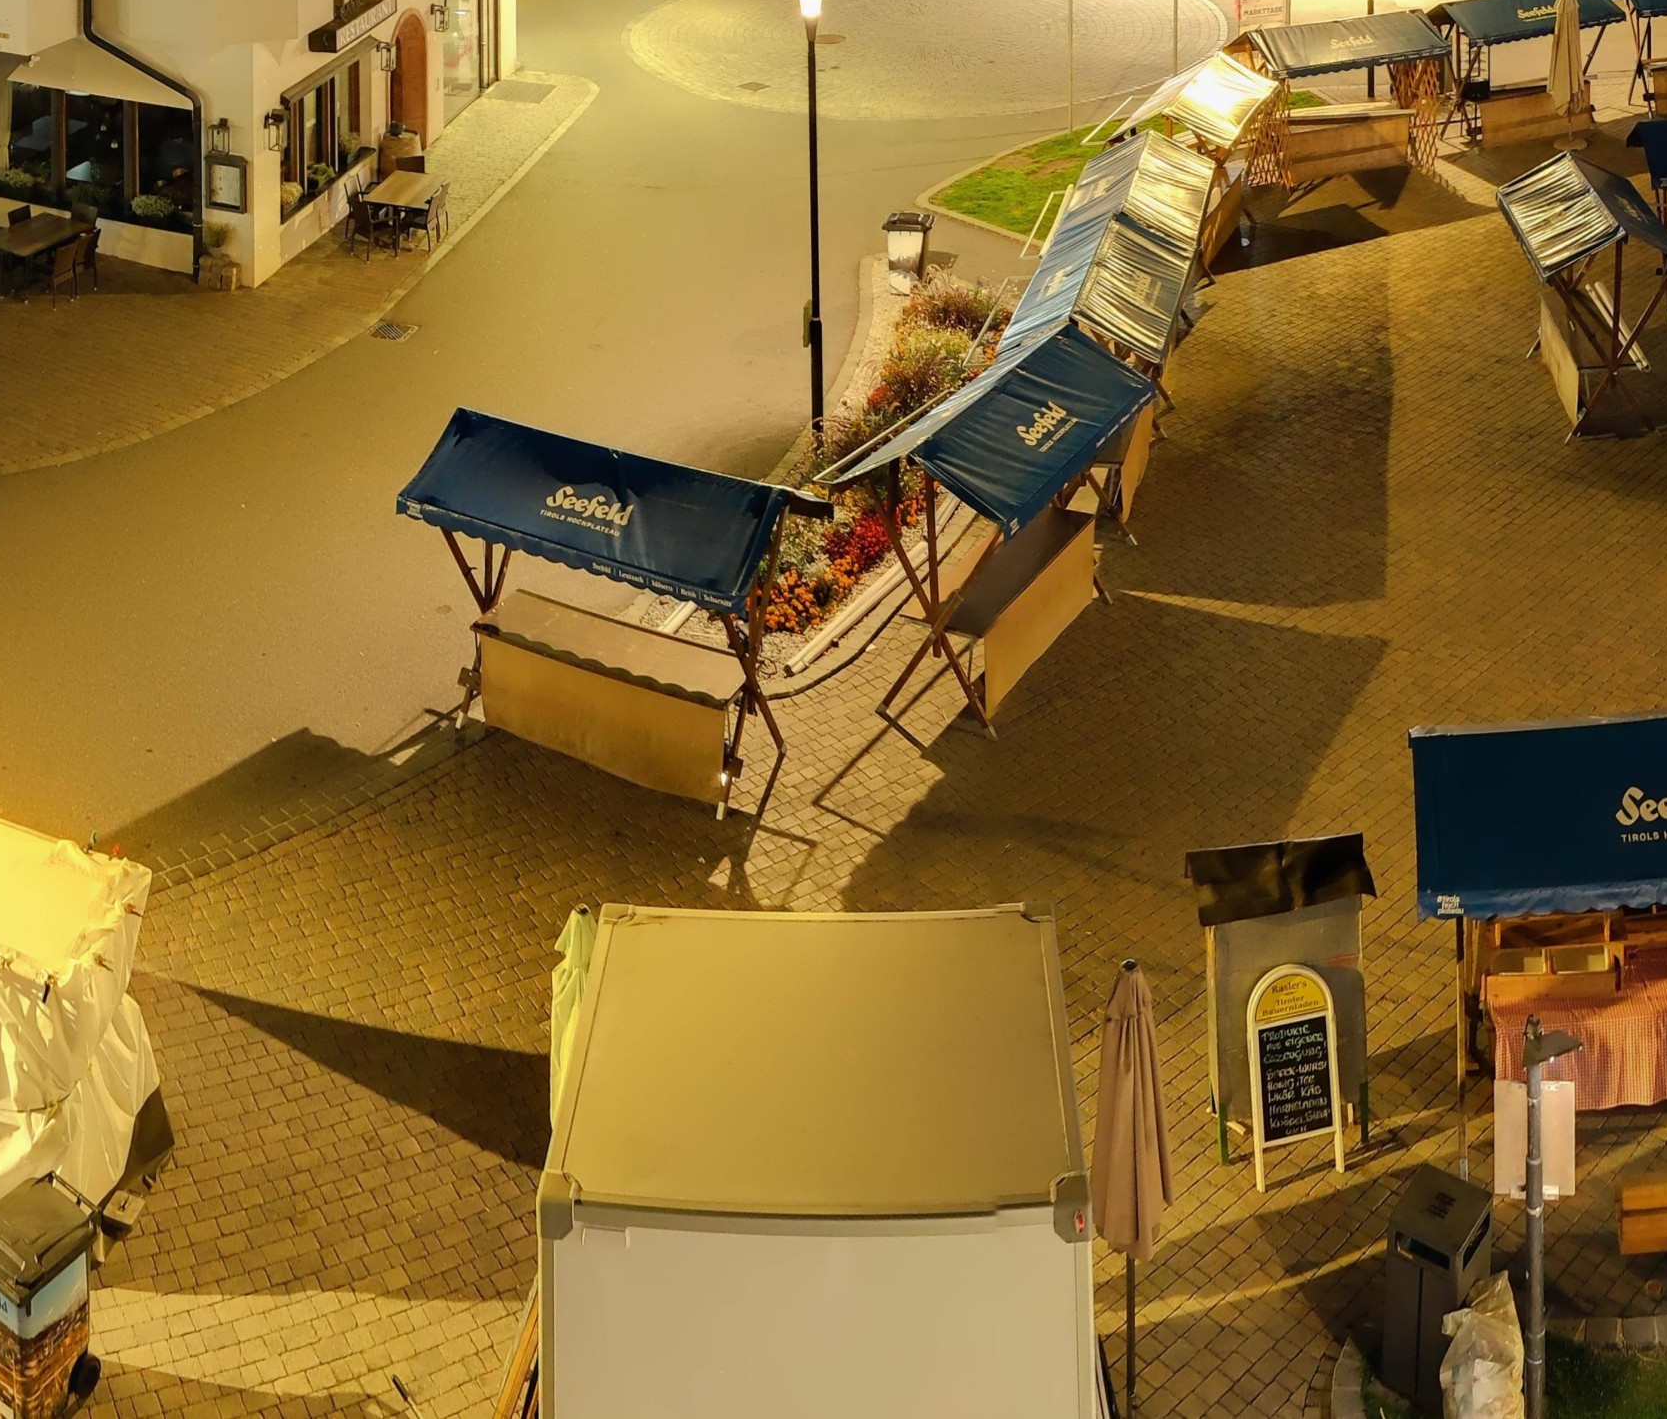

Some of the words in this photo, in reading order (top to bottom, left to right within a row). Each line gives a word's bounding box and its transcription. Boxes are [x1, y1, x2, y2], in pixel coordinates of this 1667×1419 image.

[1017, 401, 1067, 446] Seefeld
[546, 485, 634, 526] Seefeld
[540, 509, 565, 522] TIROLS
[566, 516, 620, 537] HOCHPLATEAU
[1620, 831, 1660, 844] TIROLS
[1262, 999, 1319, 1016] Bauernladen
[1275, 995, 1304, 1007] Tiroler
